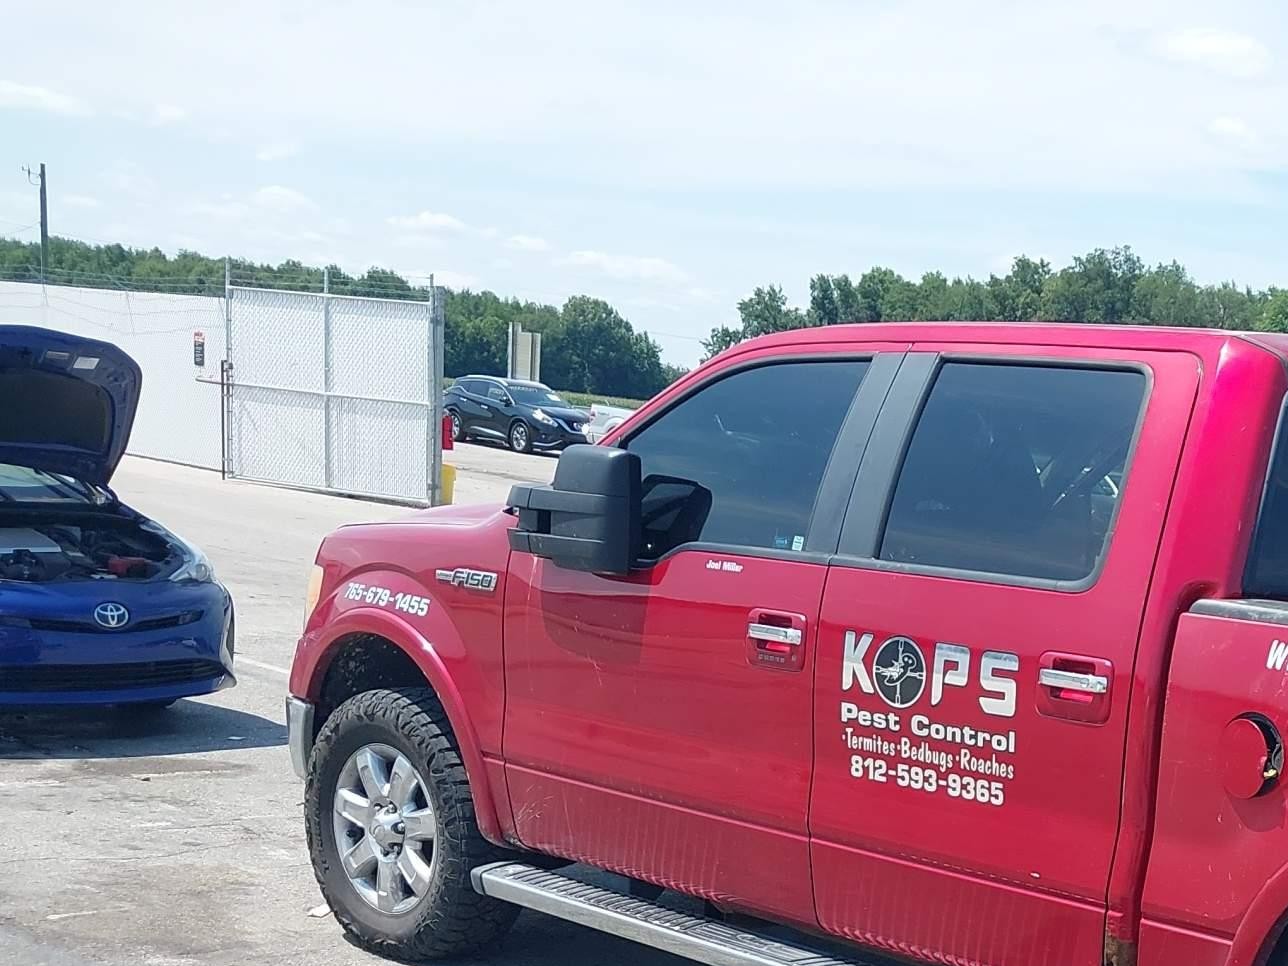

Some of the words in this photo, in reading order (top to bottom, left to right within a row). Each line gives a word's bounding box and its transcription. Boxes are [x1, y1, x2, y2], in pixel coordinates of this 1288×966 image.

[705, 560, 721, 570] Joel
[722, 561, 743, 572] Miller
[344, 582, 431, 617] 765-679-1455
[842, 630, 1019, 717] KOPS
[840, 702, 900, 731] Pest
[911, 714, 1016, 753] Control
[850, 755, 1004, 805] 812-593-9365
